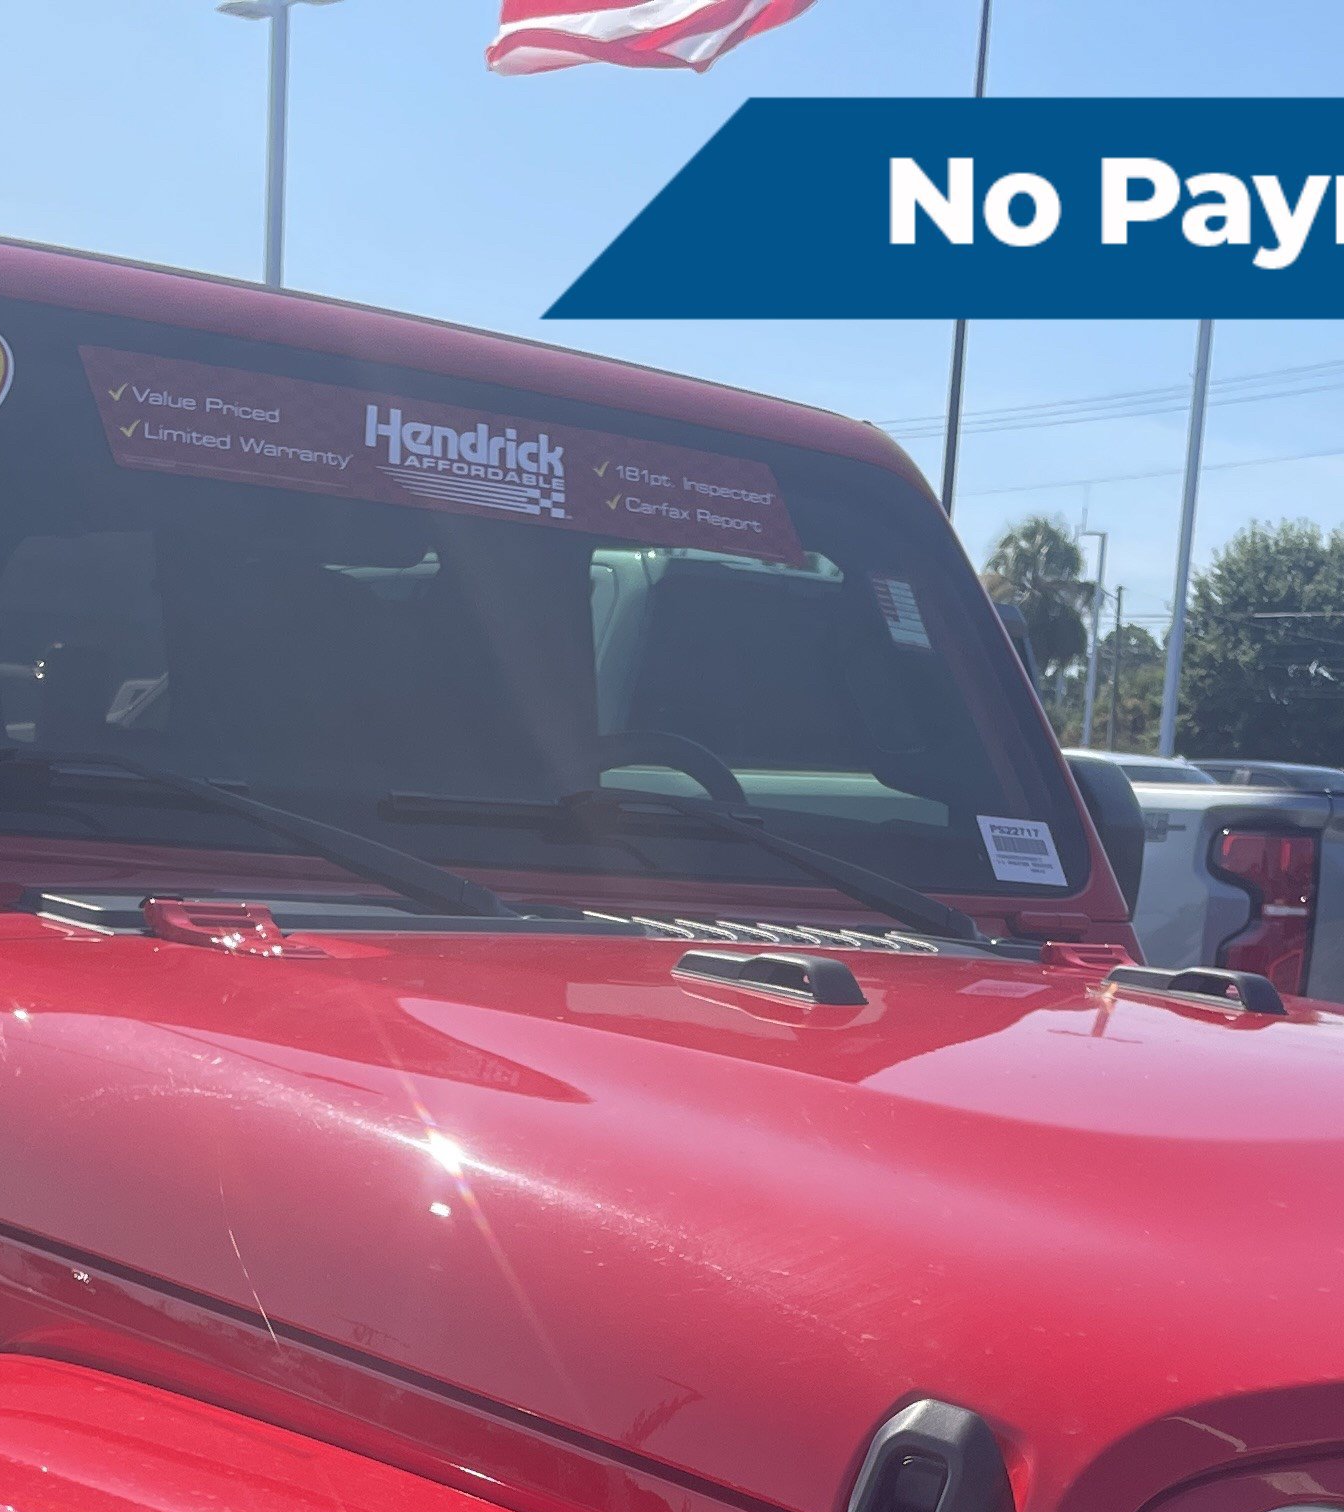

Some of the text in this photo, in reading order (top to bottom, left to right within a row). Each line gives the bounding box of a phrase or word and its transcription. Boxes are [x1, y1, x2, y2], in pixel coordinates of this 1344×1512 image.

[132, 386, 281, 423] Value Priced
[143, 422, 354, 470] Limited Warranty
[365, 404, 565, 478] Hendrick
[404, 455, 566, 491] AFFORDABLE
[683, 477, 773, 505] Inspected
[625, 497, 762, 533] Carfax Report
